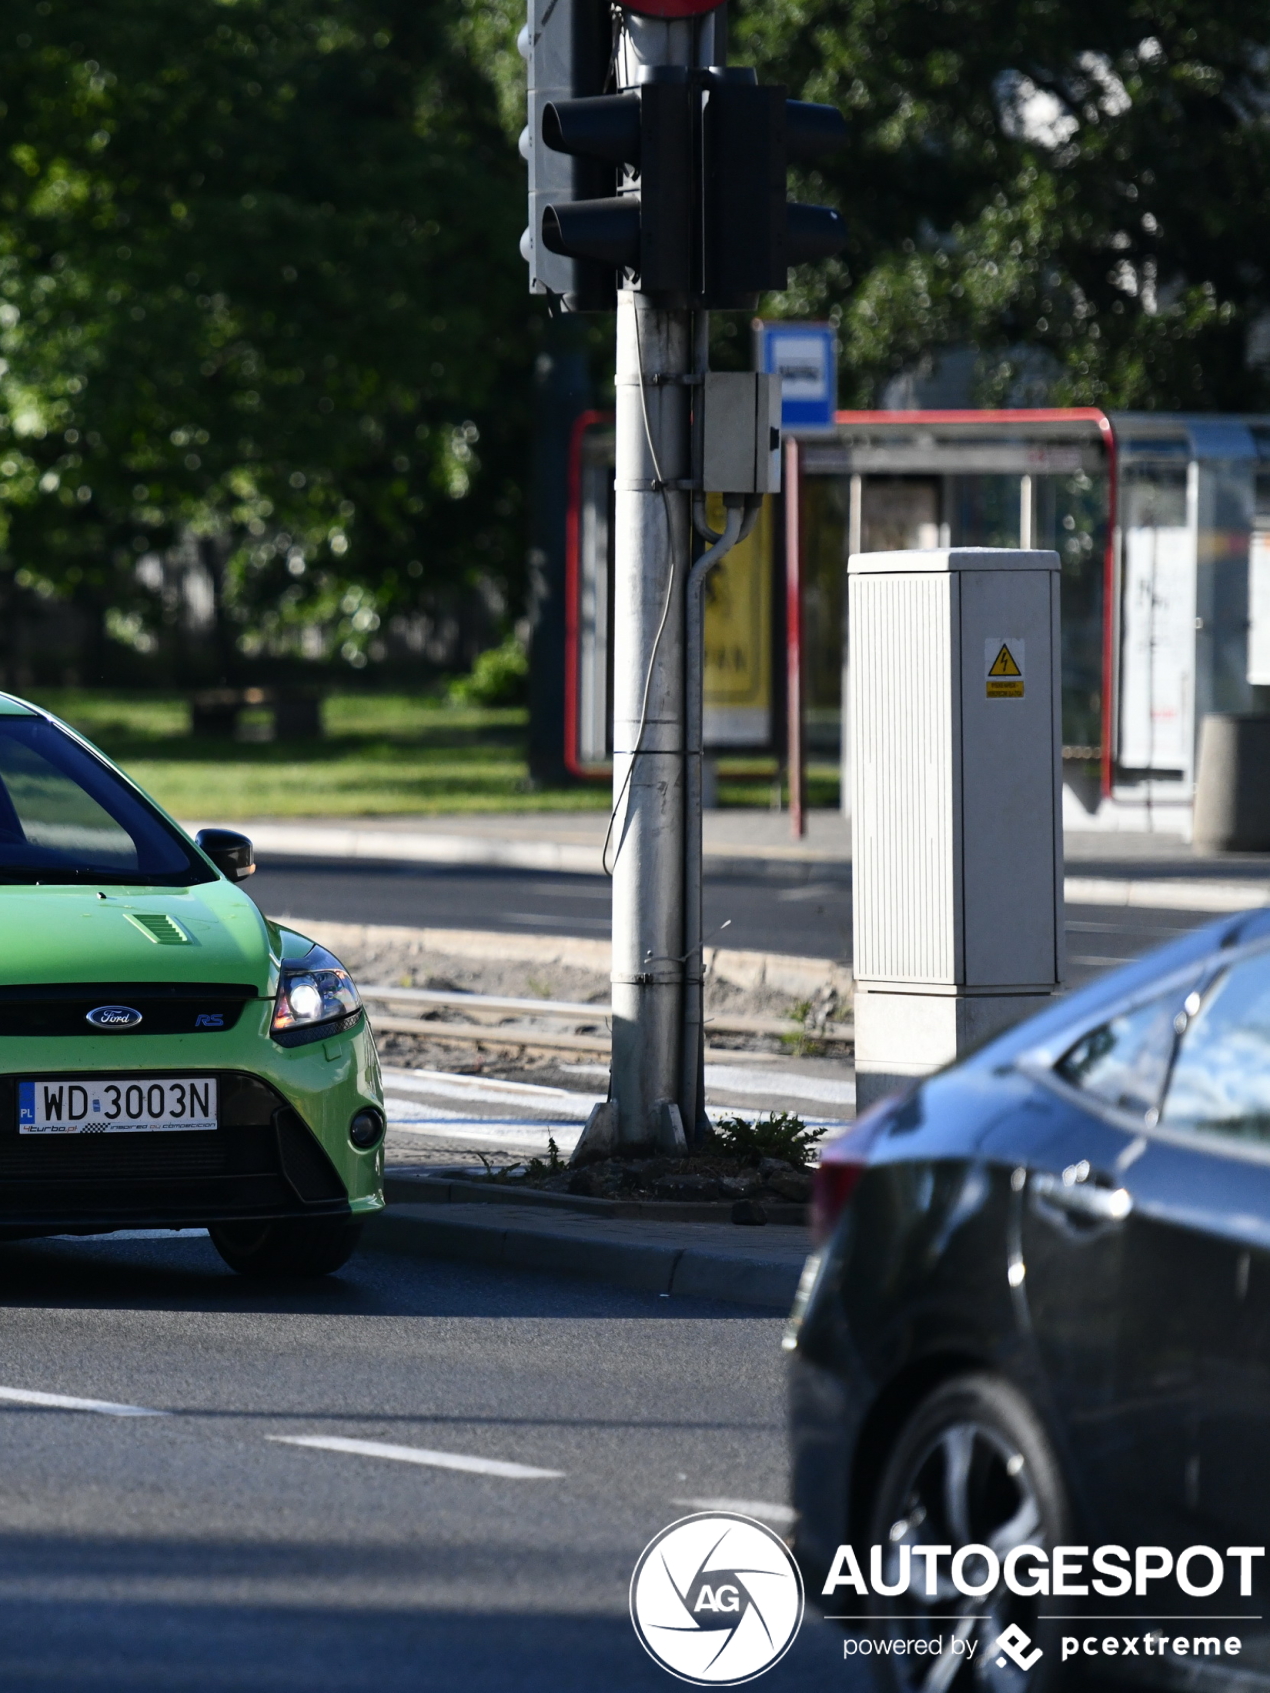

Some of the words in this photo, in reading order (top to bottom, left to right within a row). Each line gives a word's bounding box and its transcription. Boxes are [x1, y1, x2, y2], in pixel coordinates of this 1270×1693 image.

[100, 1010, 130, 1023] Ford
[195, 1014, 224, 1026] RS
[43, 1085, 88, 1121] WD
[104, 1082, 210, 1120] 3003N
[20, 1108, 33, 1118] PL
